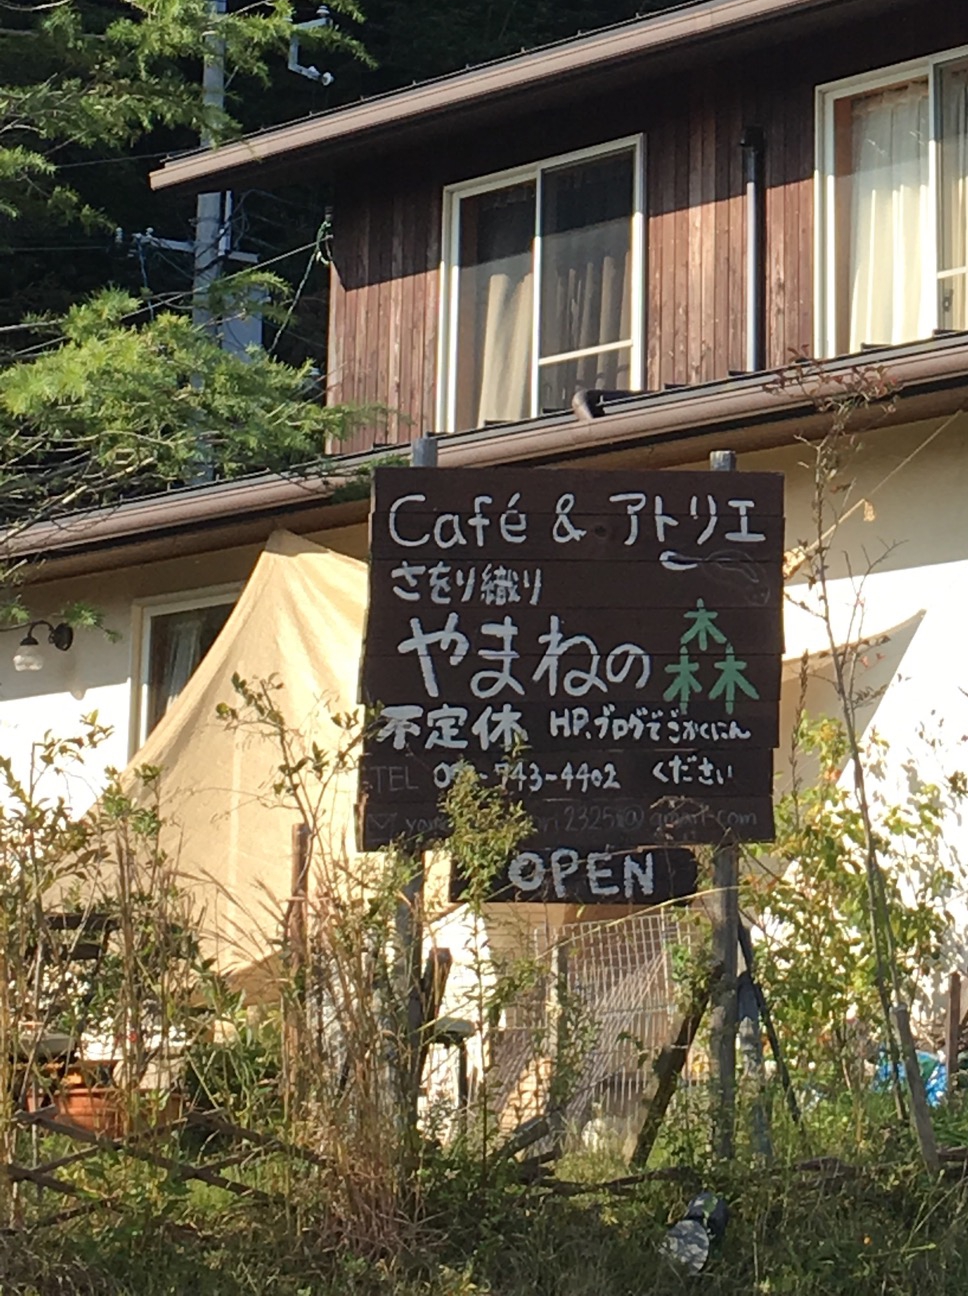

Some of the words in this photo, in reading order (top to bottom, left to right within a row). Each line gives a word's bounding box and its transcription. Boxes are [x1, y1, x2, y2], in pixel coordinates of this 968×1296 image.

[388, 492, 527, 549] Café
[552, 492, 588, 544] &
[609, 492, 767, 546] アトリエ
[391, 560, 543, 605] さをり織り
[376, 703, 529, 751] 不定休
[369, 765, 420, 793] TEL
[432, 760, 622, 794] 0-743-4402
[652, 754, 733, 786] ください
[507, 847, 654, 899] OPEN
